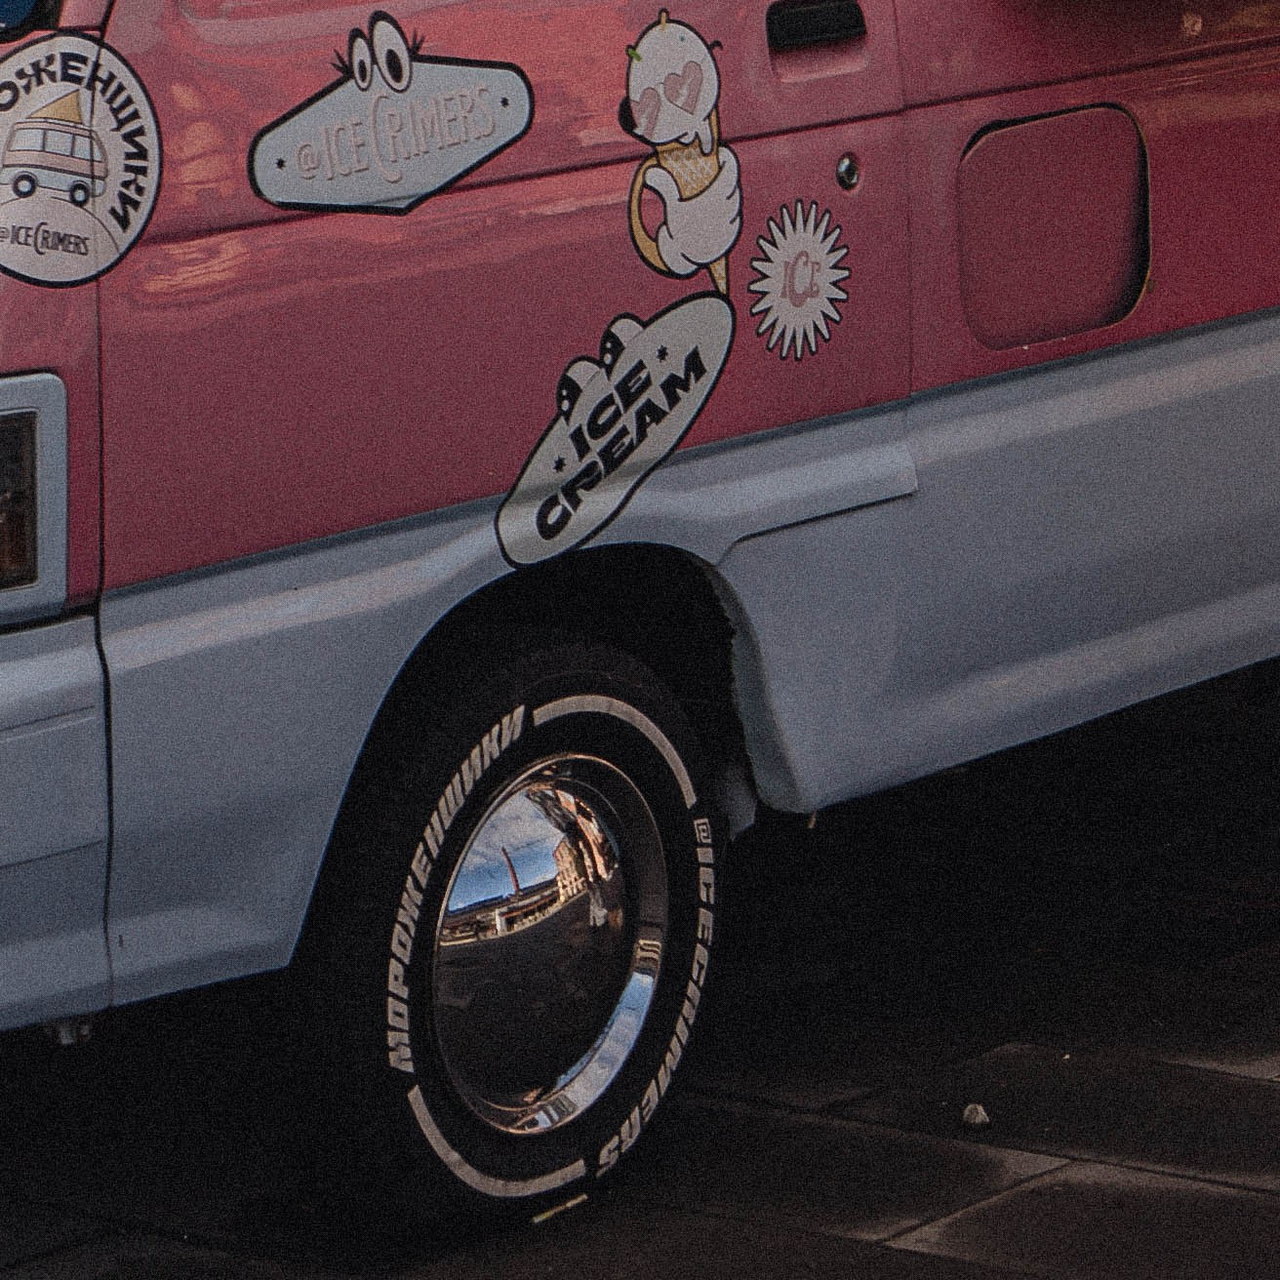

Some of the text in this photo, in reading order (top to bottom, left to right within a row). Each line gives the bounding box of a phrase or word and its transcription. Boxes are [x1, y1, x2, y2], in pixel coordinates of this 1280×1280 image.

[536, 345, 708, 541] CREAM
[569, 359, 653, 460] ICE
[388, 704, 525, 1073] МОРОЖЕНЩИКИ
